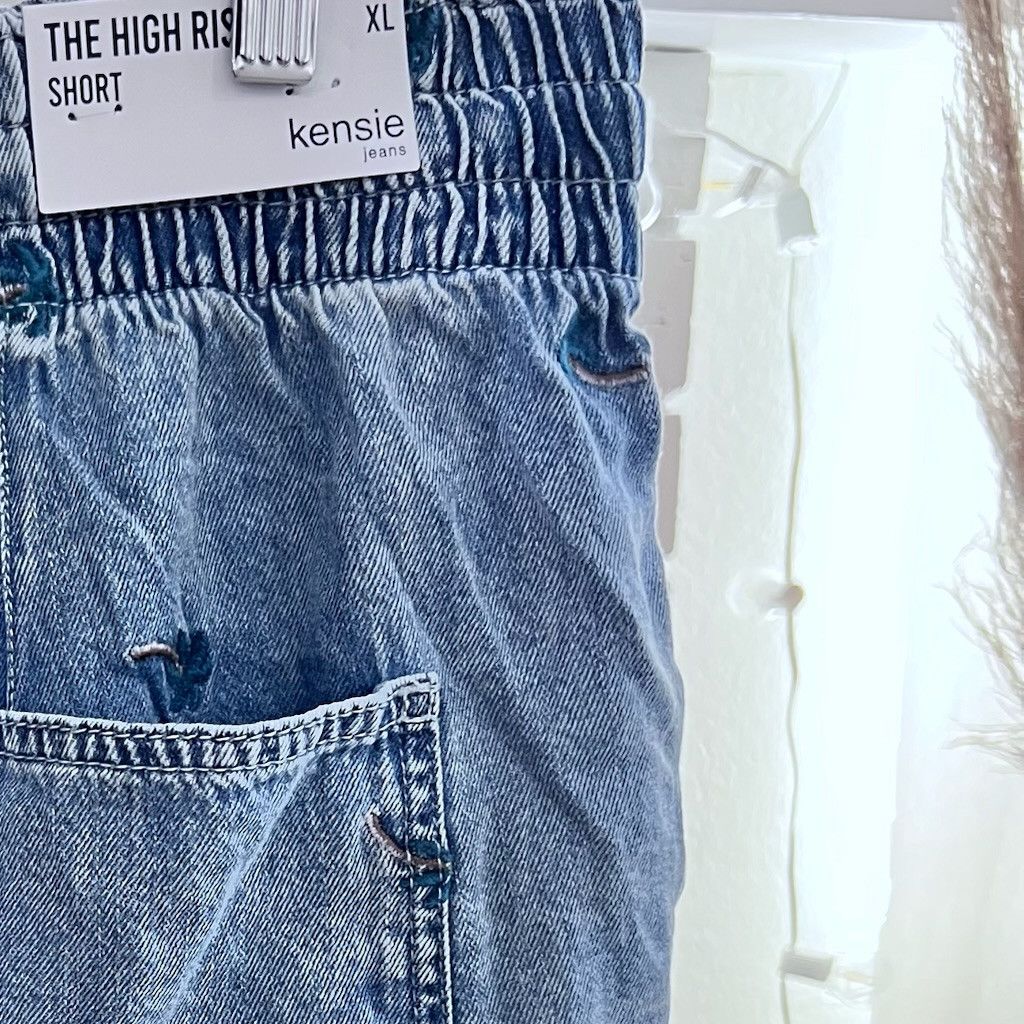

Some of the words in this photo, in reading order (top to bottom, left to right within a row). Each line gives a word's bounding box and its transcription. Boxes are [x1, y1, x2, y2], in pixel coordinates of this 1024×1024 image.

[44, 20, 102, 62] THE
[111, 13, 181, 57] HIGH
[191, 7, 233, 50] RIS
[366, 3, 395, 33] XL
[48, 72, 123, 107] SHORT
[289, 109, 405, 150] kensie
[362, 145, 407, 163] jeans
